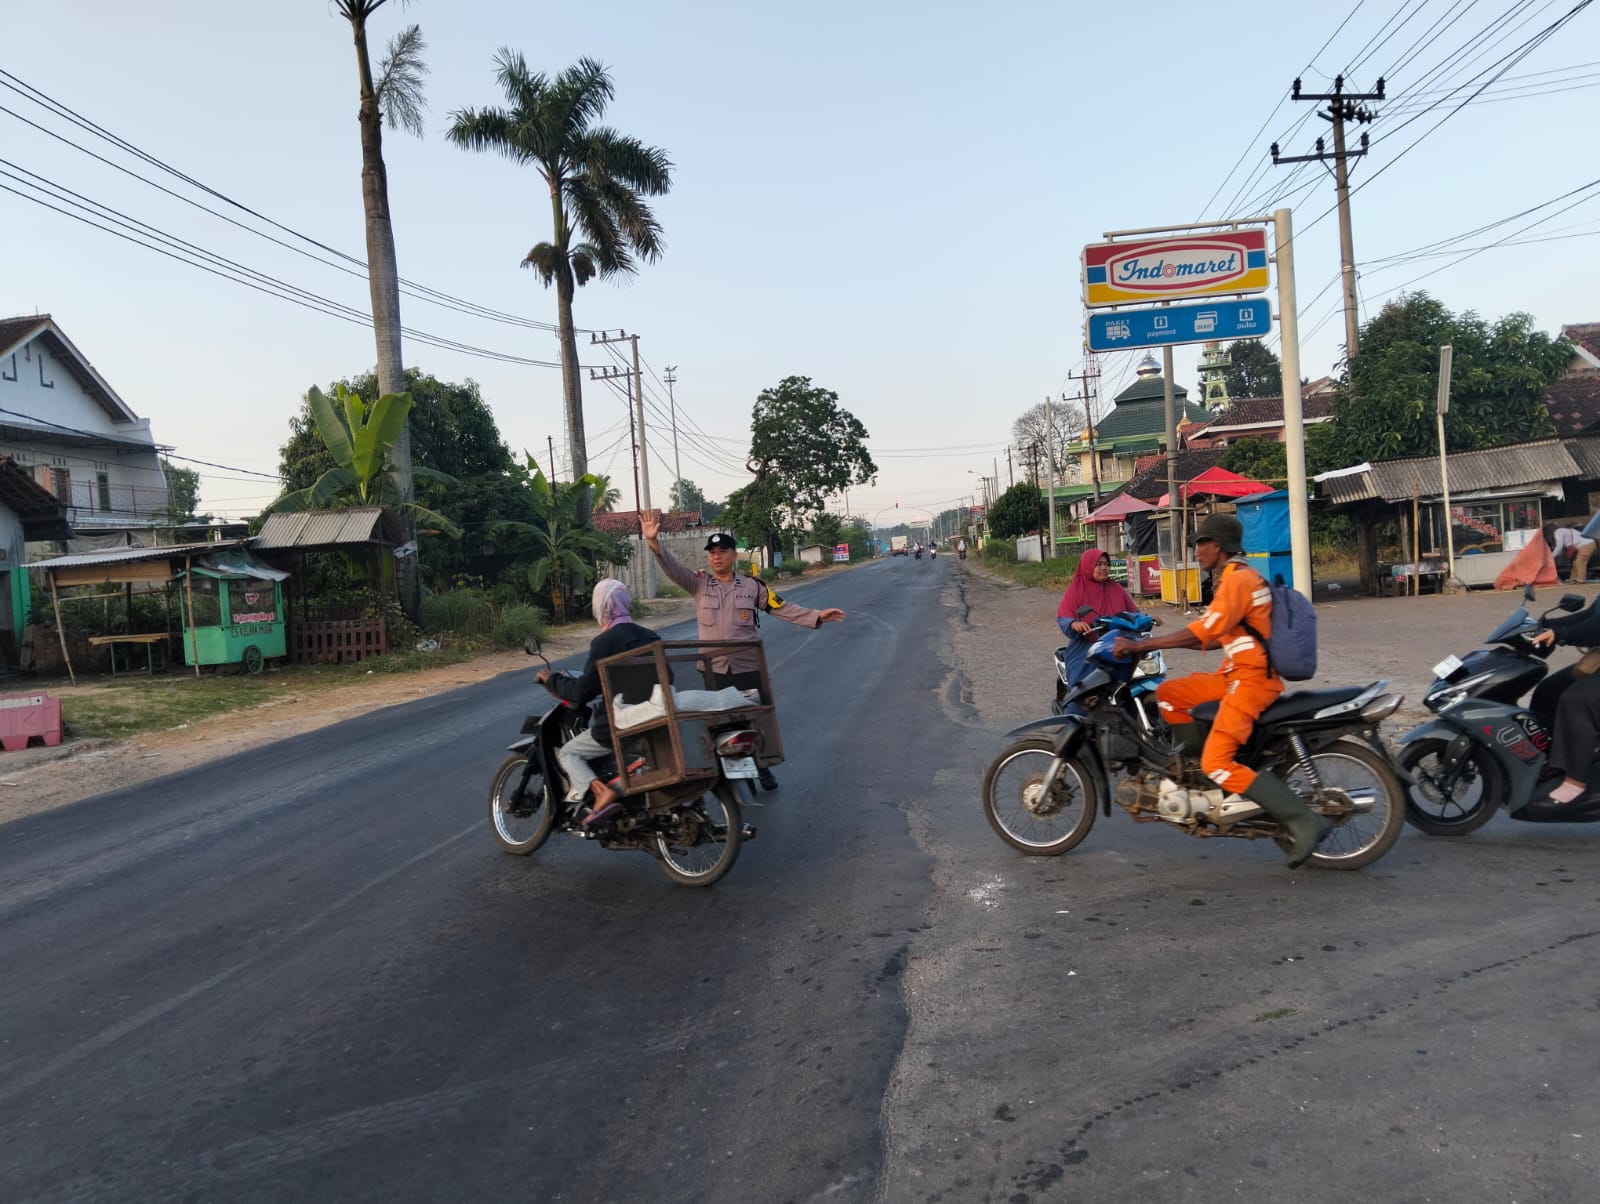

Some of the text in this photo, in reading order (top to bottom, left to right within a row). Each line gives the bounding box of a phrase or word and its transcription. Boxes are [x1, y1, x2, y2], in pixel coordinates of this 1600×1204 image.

[1118, 253, 1236, 281] Indomaret
[1236, 321, 1257, 331] pulsa
[1146, 329, 1177, 339] payment
